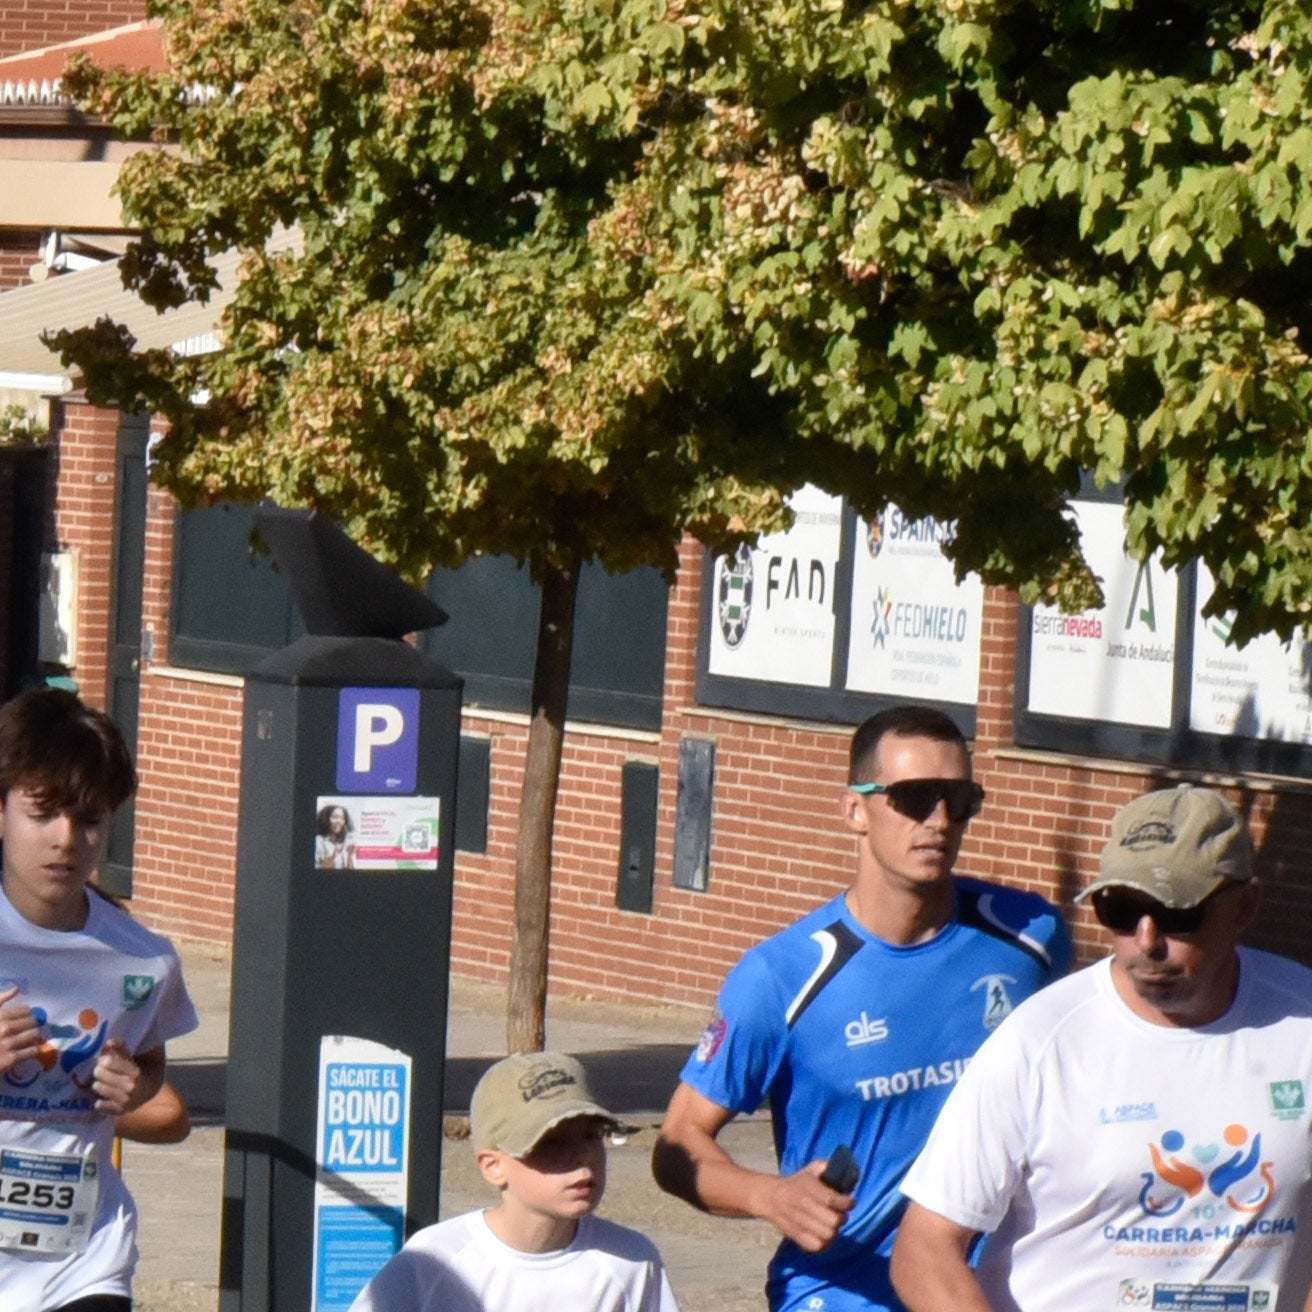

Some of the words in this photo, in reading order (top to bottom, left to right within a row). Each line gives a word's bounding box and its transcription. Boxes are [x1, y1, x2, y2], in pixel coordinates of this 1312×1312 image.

[894, 602, 967, 642] FEDHIELO
[1033, 613, 1102, 639] sierranevada
[1129, 641, 1137, 660] de
[354, 704, 404, 772] P
[330, 1066, 379, 1088] SÁCATE
[383, 1069, 399, 1088] EL
[328, 1089, 400, 1125] BONO
[327, 1129, 398, 1165] AZUL
[1103, 1217, 1297, 1243] CARRERA-MARCHA
